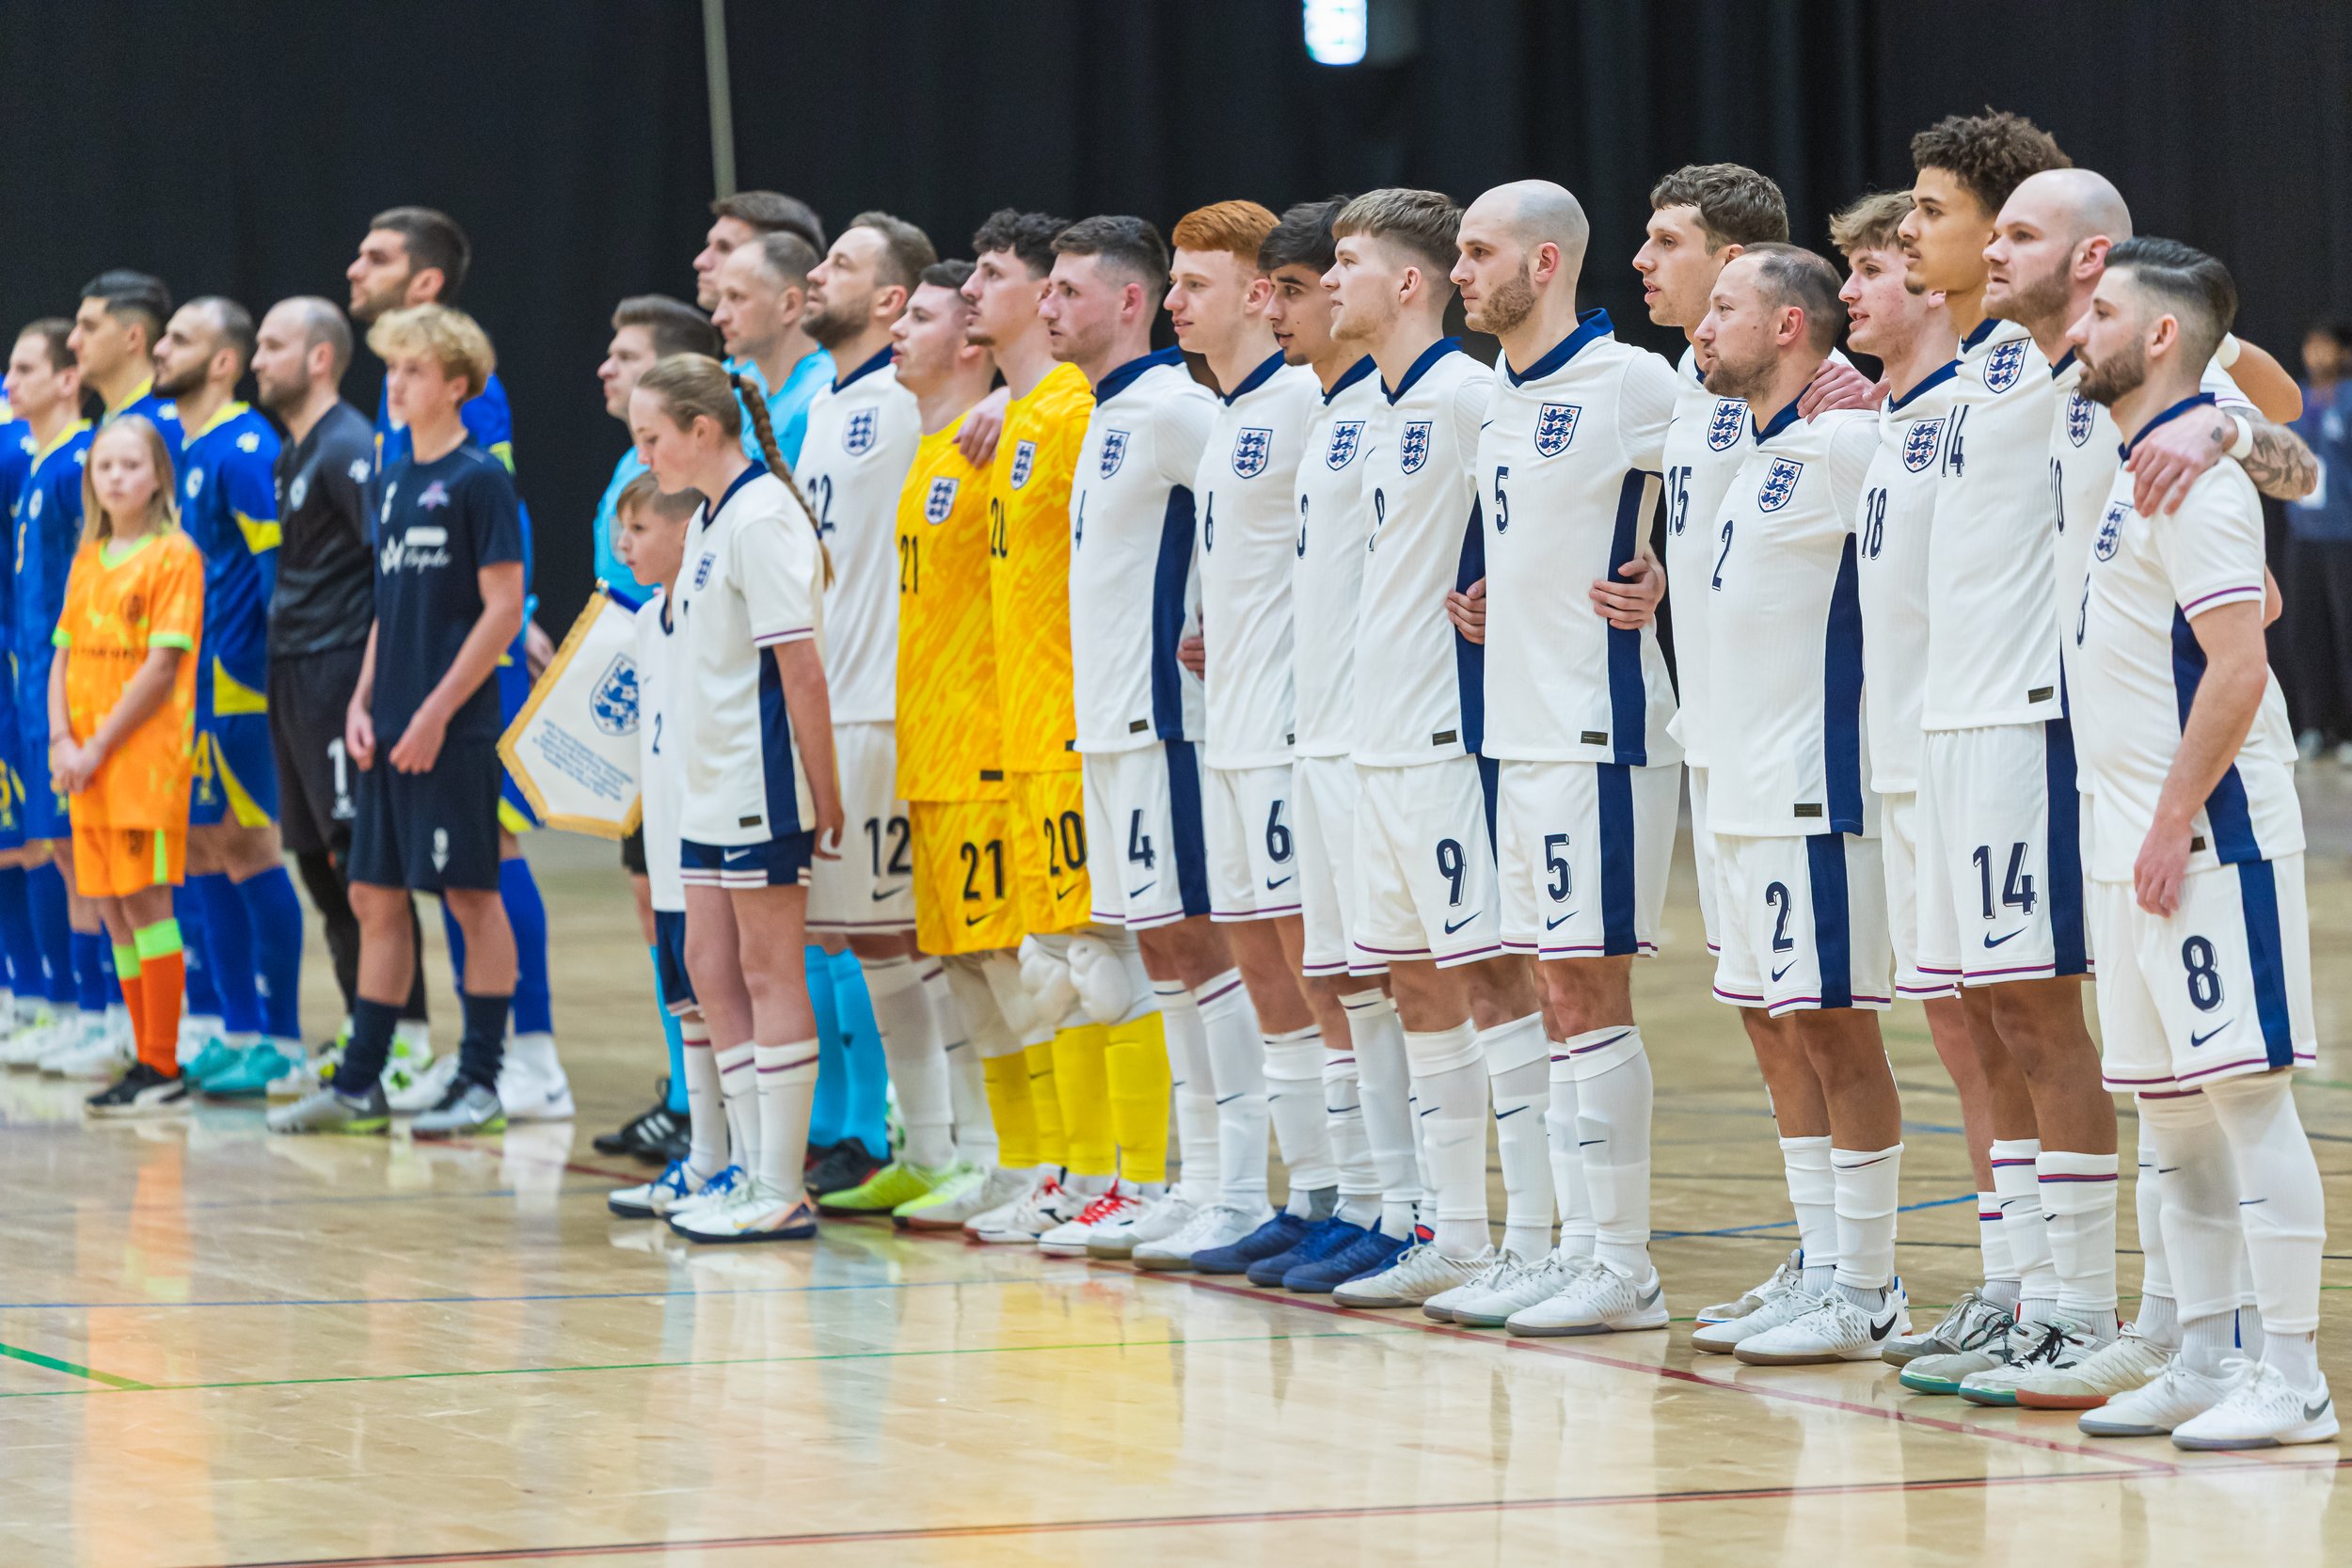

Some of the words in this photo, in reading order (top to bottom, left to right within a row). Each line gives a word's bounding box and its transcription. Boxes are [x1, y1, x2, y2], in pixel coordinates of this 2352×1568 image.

[1942, 404, 1970, 478] 14
[1205, 491, 1214, 555] 6
[1495, 466, 1510, 534] 5
[1668, 466, 1692, 536] 15
[1862, 487, 1887, 560] 18
[900, 534, 918, 594] 21
[1711, 519, 1734, 591] 2
[327, 737, 347, 796] 1
[651, 712, 662, 755] 2
[864, 816, 912, 877] 12
[1043, 810, 1087, 877] 20
[1129, 809, 1156, 870] 4
[1266, 800, 1295, 863] 6
[960, 839, 1005, 900] 21
[1436, 838, 1468, 907] 9
[1545, 833, 1572, 904] 5
[1973, 843, 2038, 920] 14
[1766, 881, 1794, 954] 2
[2181, 936, 2225, 1013] 8
